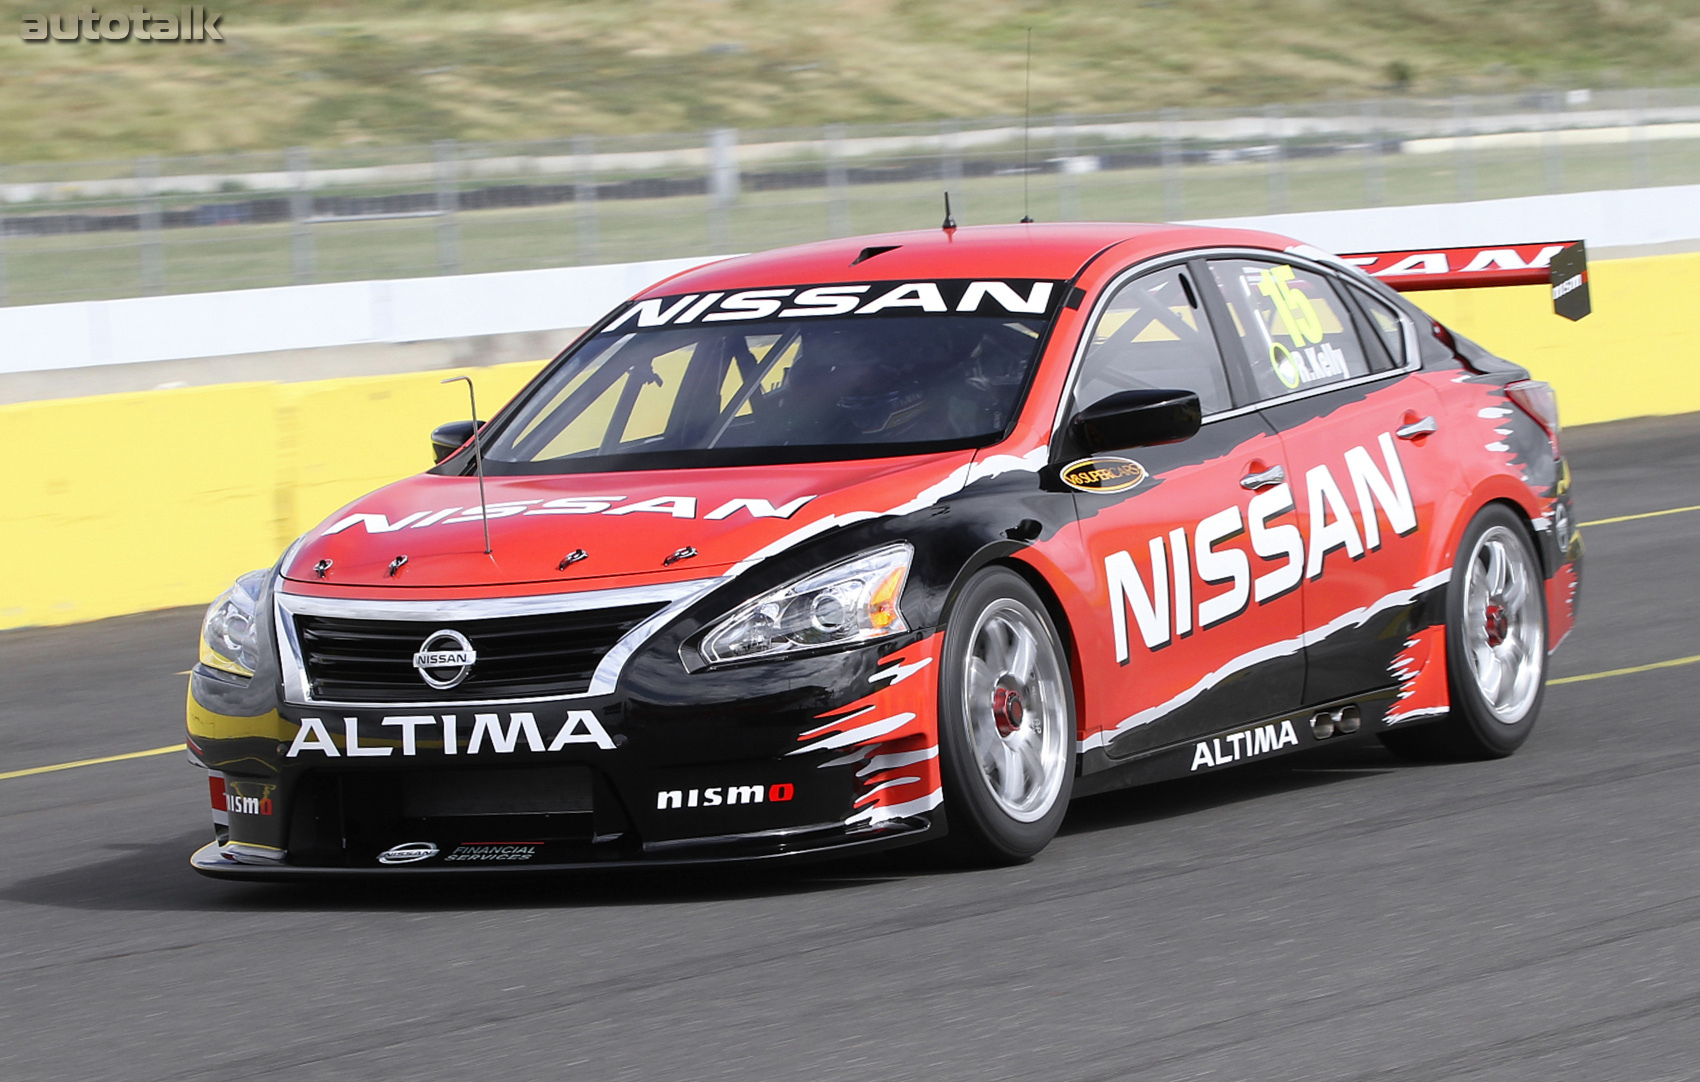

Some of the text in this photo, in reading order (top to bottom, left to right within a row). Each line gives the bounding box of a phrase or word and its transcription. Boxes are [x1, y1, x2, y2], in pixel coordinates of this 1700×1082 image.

[601, 281, 1054, 333] NISSAN
[1257, 265, 1323, 348] 15
[321, 494, 816, 537] NISSAN
[1105, 432, 1418, 664] NISSAN
[417, 654, 467, 665] NISSAN
[286, 709, 617, 758] ALTIMA
[1190, 719, 1298, 771] ALTIMA
[222, 792, 273, 816] nismo
[656, 783, 795, 811] nismo
[386, 850, 431, 858] NISSAN
[453, 846, 536, 854] FINANCIAL
